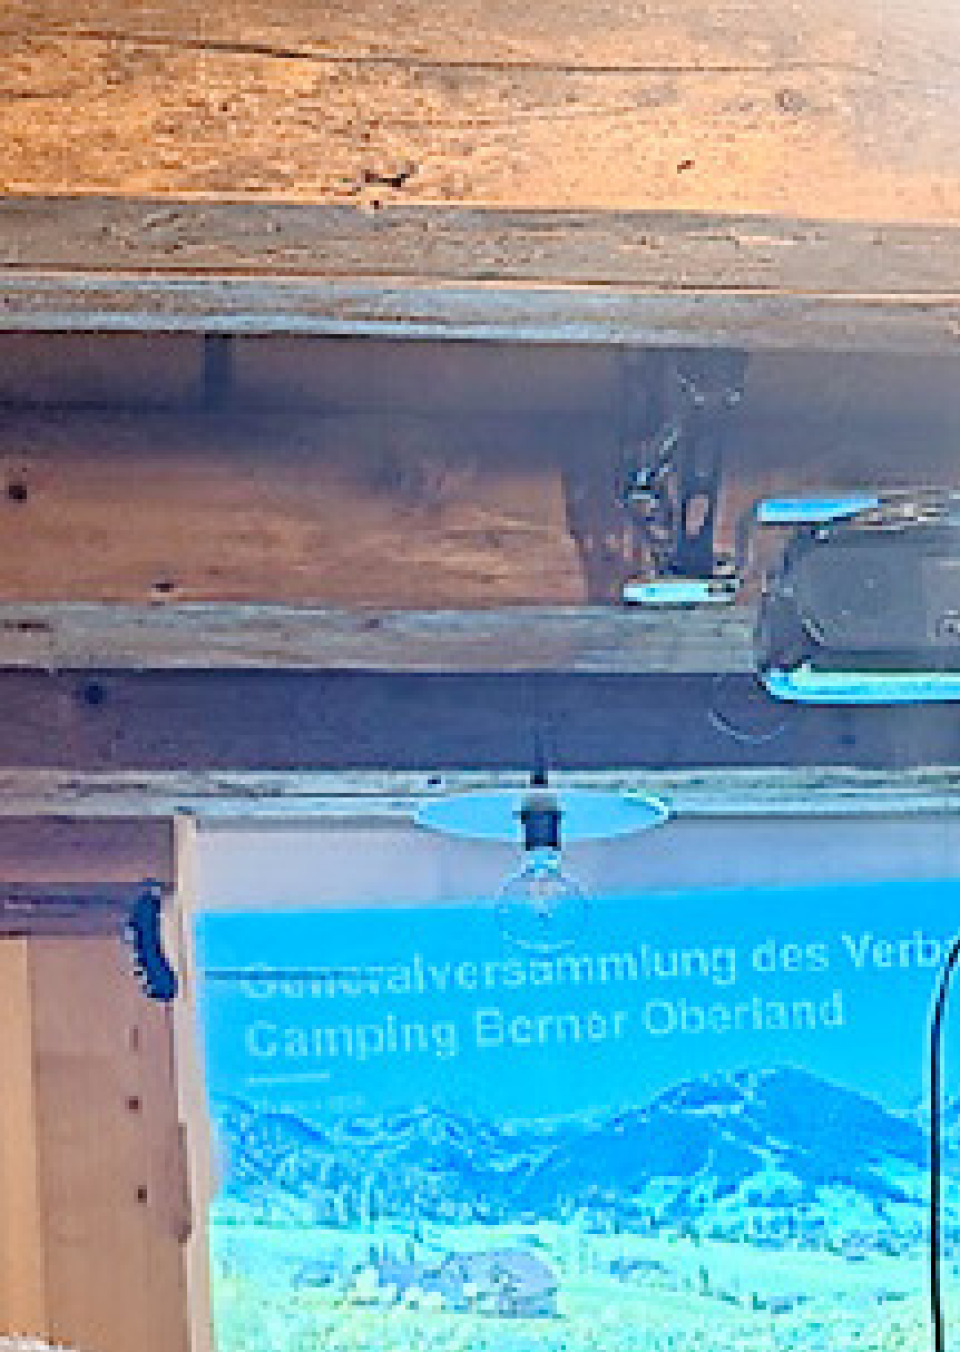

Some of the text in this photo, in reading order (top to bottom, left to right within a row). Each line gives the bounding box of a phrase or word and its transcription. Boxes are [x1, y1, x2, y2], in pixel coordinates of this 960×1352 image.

[751, 938, 829, 971] des
[246, 989, 843, 1060] Camping Berner Oberland
